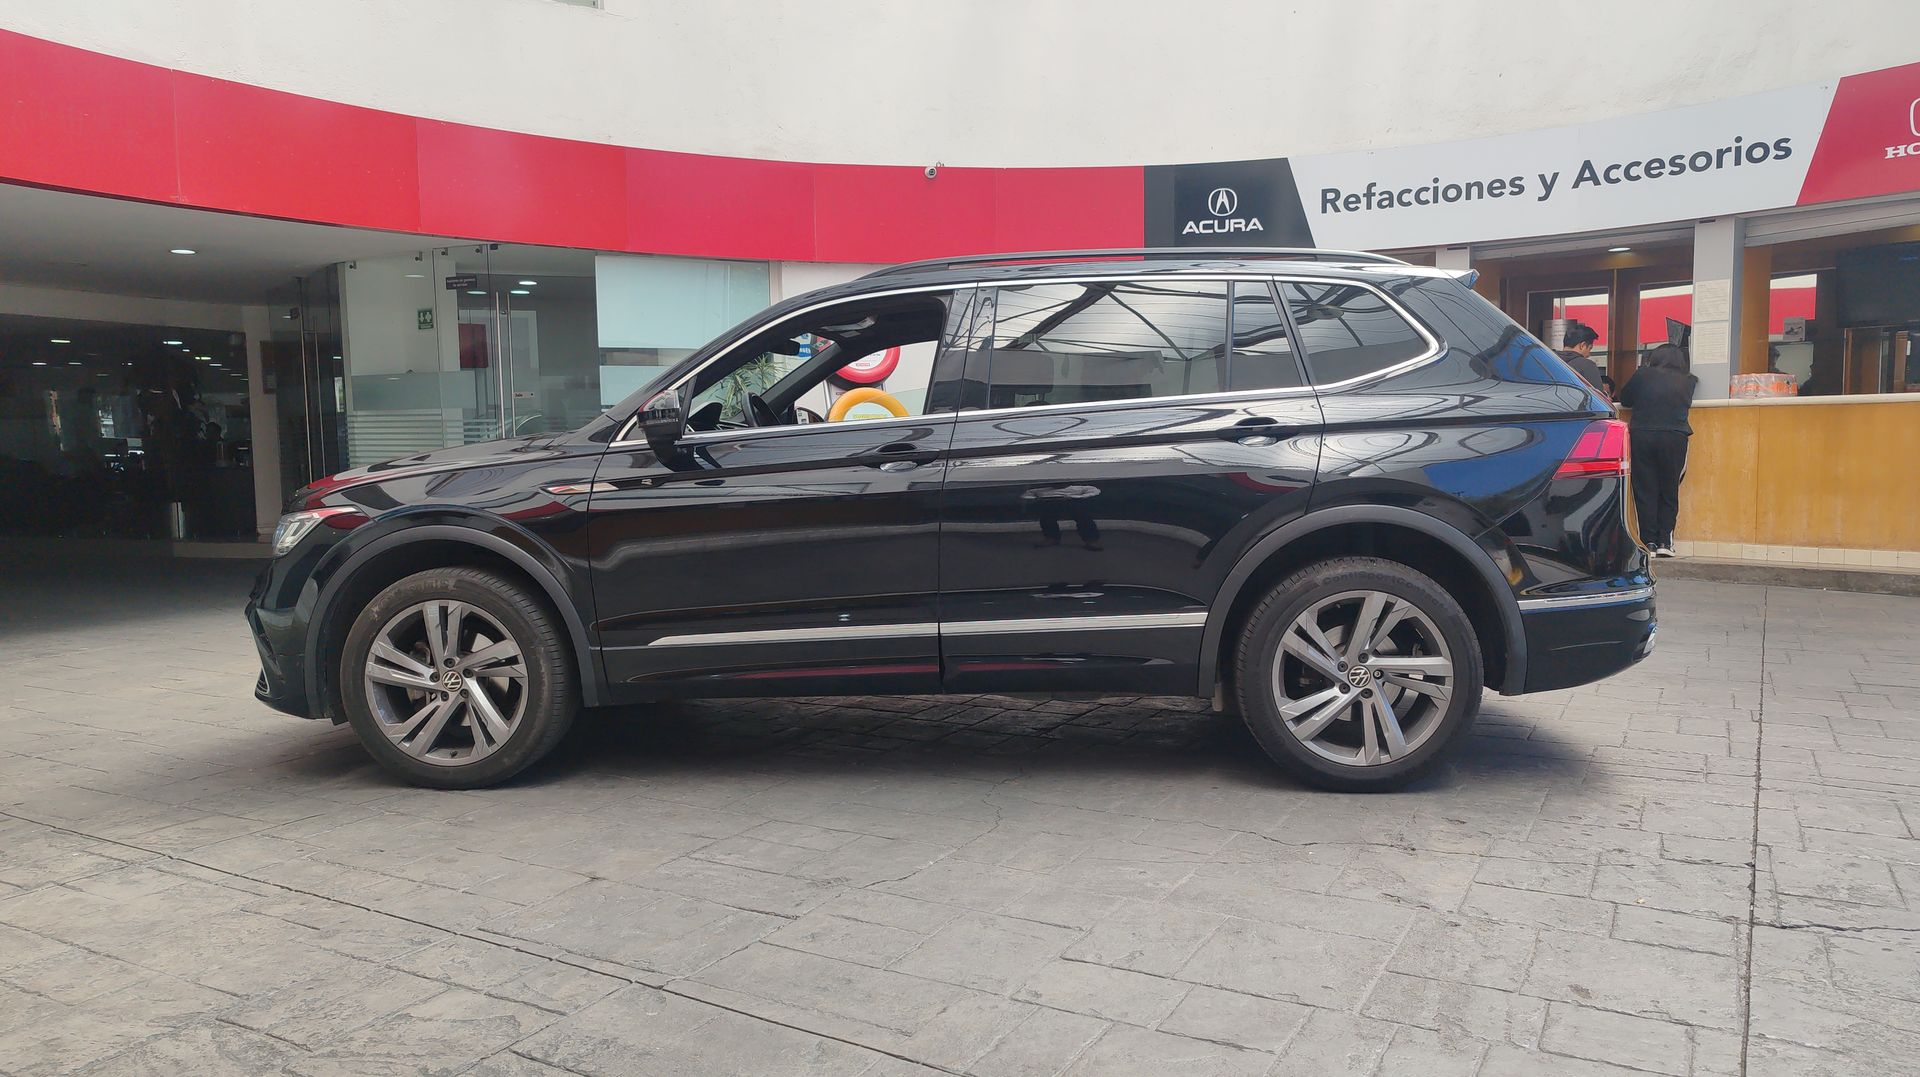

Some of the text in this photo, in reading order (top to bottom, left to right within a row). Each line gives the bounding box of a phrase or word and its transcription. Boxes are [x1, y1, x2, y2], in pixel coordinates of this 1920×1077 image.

[1321, 136, 1793, 214] Refacciones y Accesorios
[1182, 217, 1264, 235] ACURA
